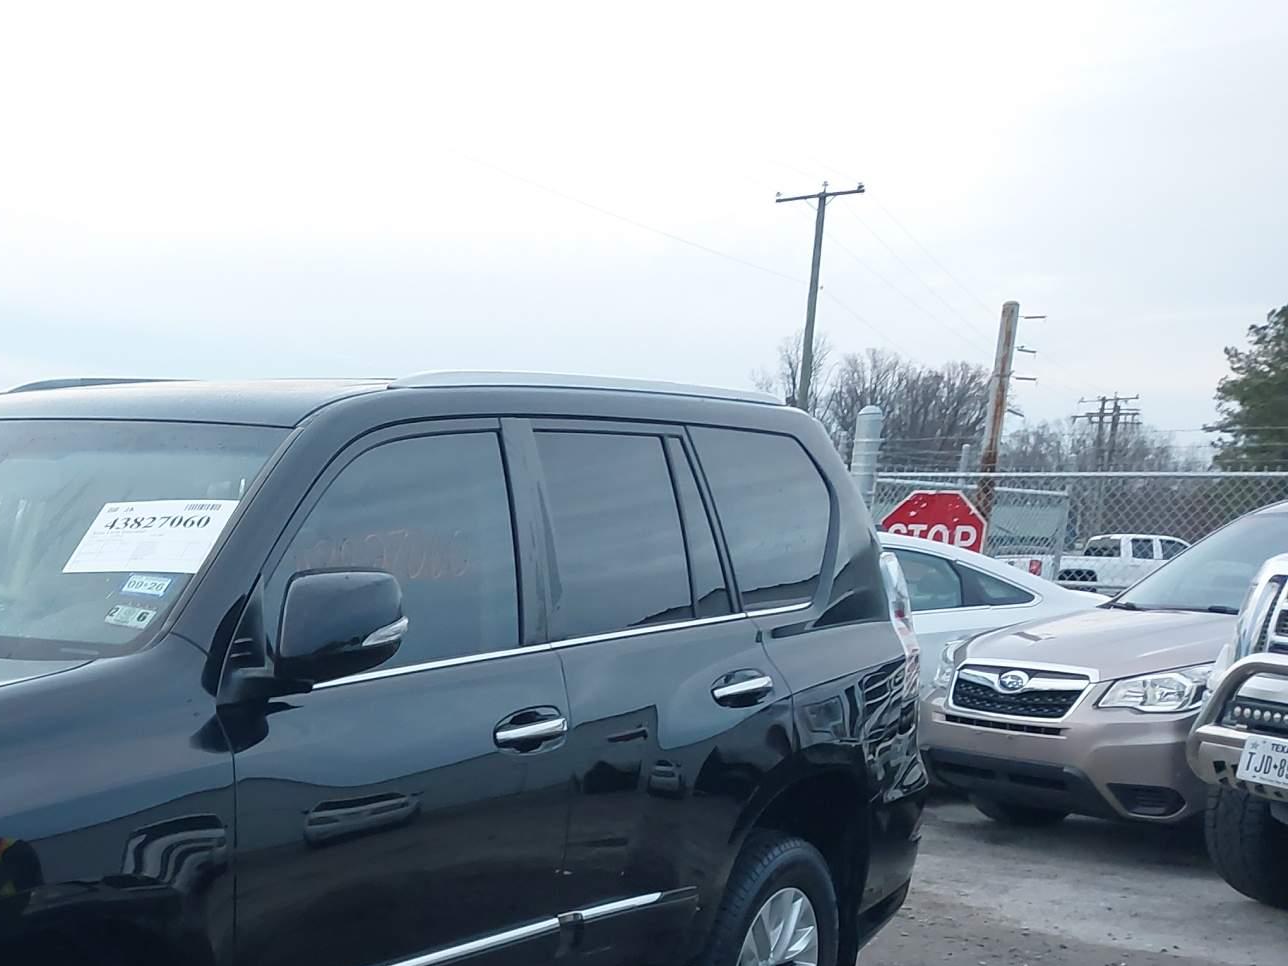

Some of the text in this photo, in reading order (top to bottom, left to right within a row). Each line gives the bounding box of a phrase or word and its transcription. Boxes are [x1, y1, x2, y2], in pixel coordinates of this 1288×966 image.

[104, 516, 211, 530] 43827060
[888, 523, 977, 547] OP
[136, 611, 150, 623] 6
[1271, 743, 1288, 753] TEX
